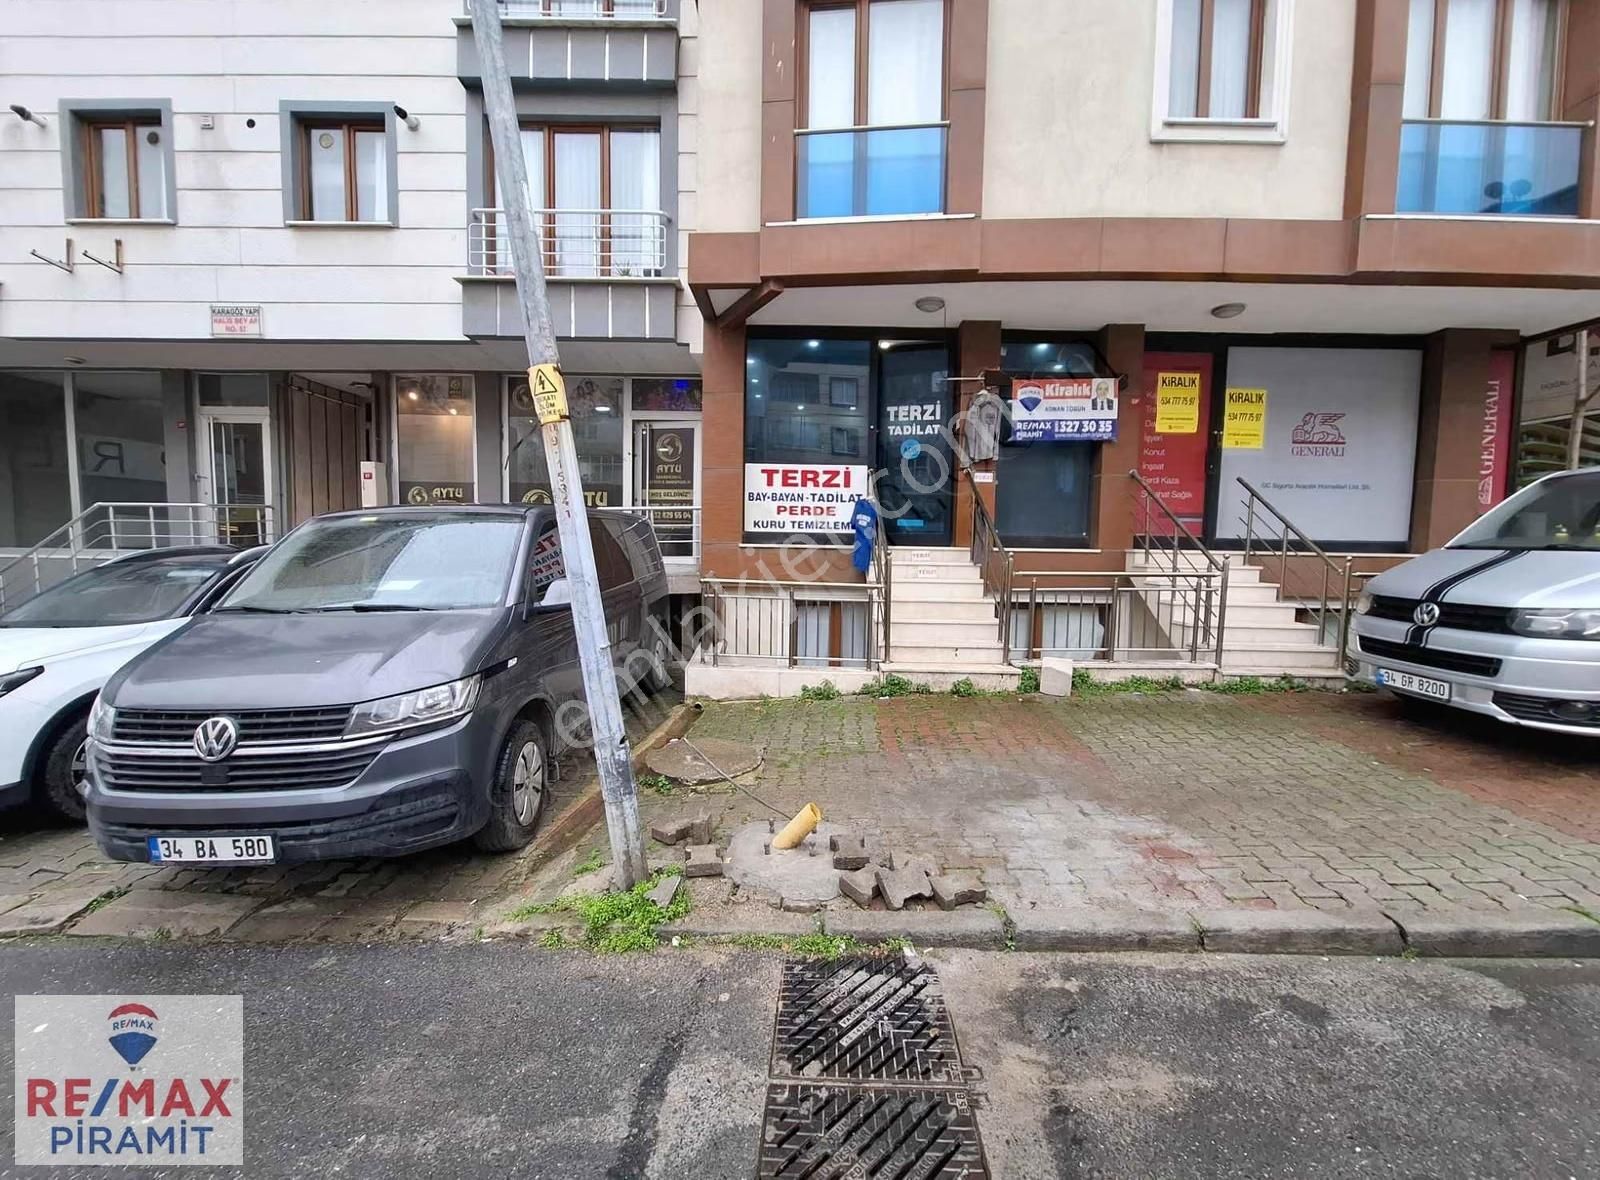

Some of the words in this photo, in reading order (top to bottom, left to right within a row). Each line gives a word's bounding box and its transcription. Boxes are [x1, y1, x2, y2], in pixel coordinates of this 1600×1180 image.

[886, 401, 942, 421] TERZİ
[888, 423, 941, 436] TADİLAT
[1060, 420, 1080, 433] 327
[1081, 420, 1097, 433] 30
[1098, 420, 1113, 433] 35
[1143, 448, 1166, 457] Konut
[1291, 446, 1345, 457] GENERALI
[656, 464, 682, 473] AYTU
[760, 466, 851, 488] TERZİ
[432, 487, 463, 498] AYTU
[810, 490, 863, 503] TADİLAT
[776, 505, 837, 517] PERDE
[753, 520, 786, 529] KURU
[790, 519, 856, 531] TEMİZLEM
[1384, 671, 1396, 684] 34
[1401, 674, 1414, 688] GR
[1417, 679, 1446, 697] 8200
[161, 839, 183, 859] 34
[194, 839, 219, 859] BA
[231, 838, 268, 858] 580
